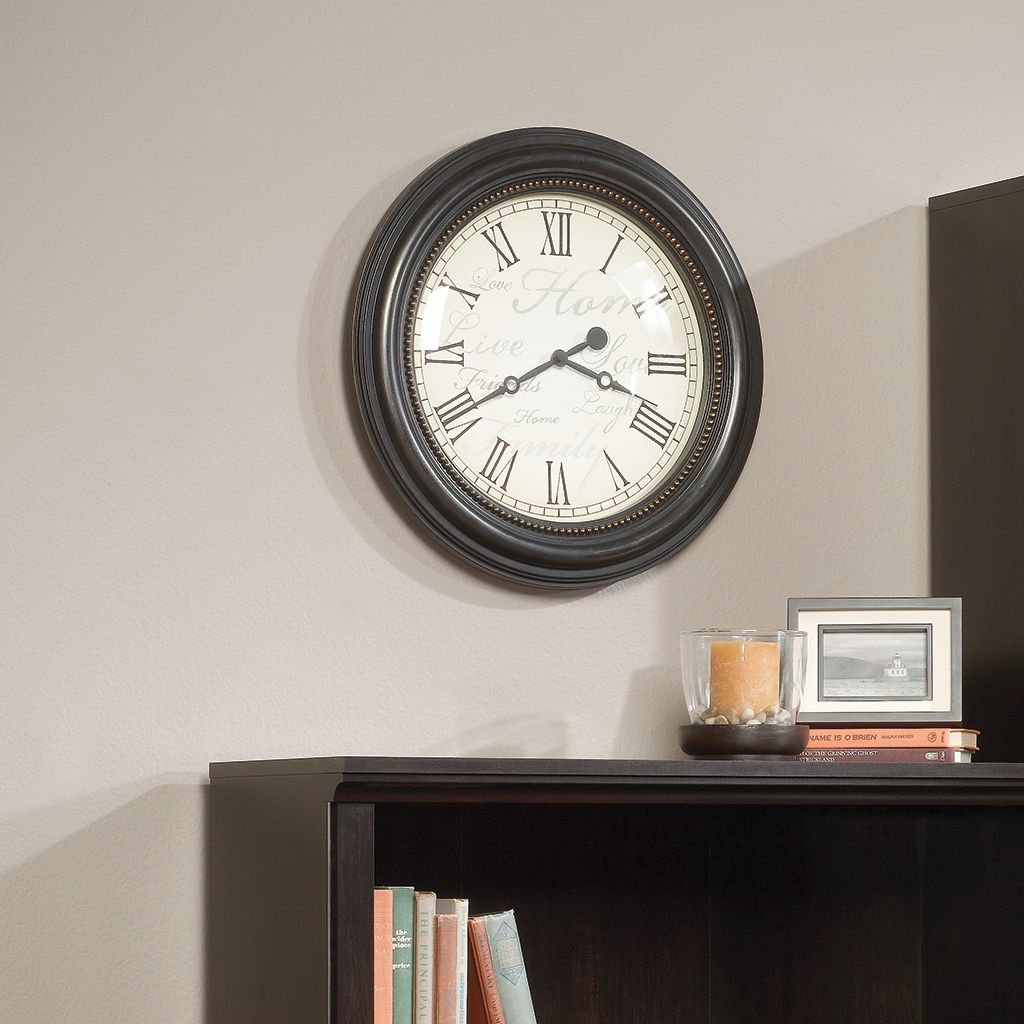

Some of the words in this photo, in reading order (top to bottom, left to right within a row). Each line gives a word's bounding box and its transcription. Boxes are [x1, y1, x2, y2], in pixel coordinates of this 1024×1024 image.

[481, 222, 520, 272] XI
[540, 211, 572, 257] XII
[600, 234, 624, 274] I
[439, 272, 480, 310] X
[469, 267, 513, 291] Love
[425, 340, 464, 367] IX
[439, 311, 527, 357] Live
[647, 351, 688, 378] III
[433, 387, 482, 446] VIII
[513, 408, 561, 425] Home
[572, 391, 635, 434] Laugh
[479, 436, 518, 492] VII
[546, 460, 571, 506] VI
[603, 449, 631, 492] V
[419, 911, 428, 936] THE
[419, 944, 428, 1020] PRINCIPAL
